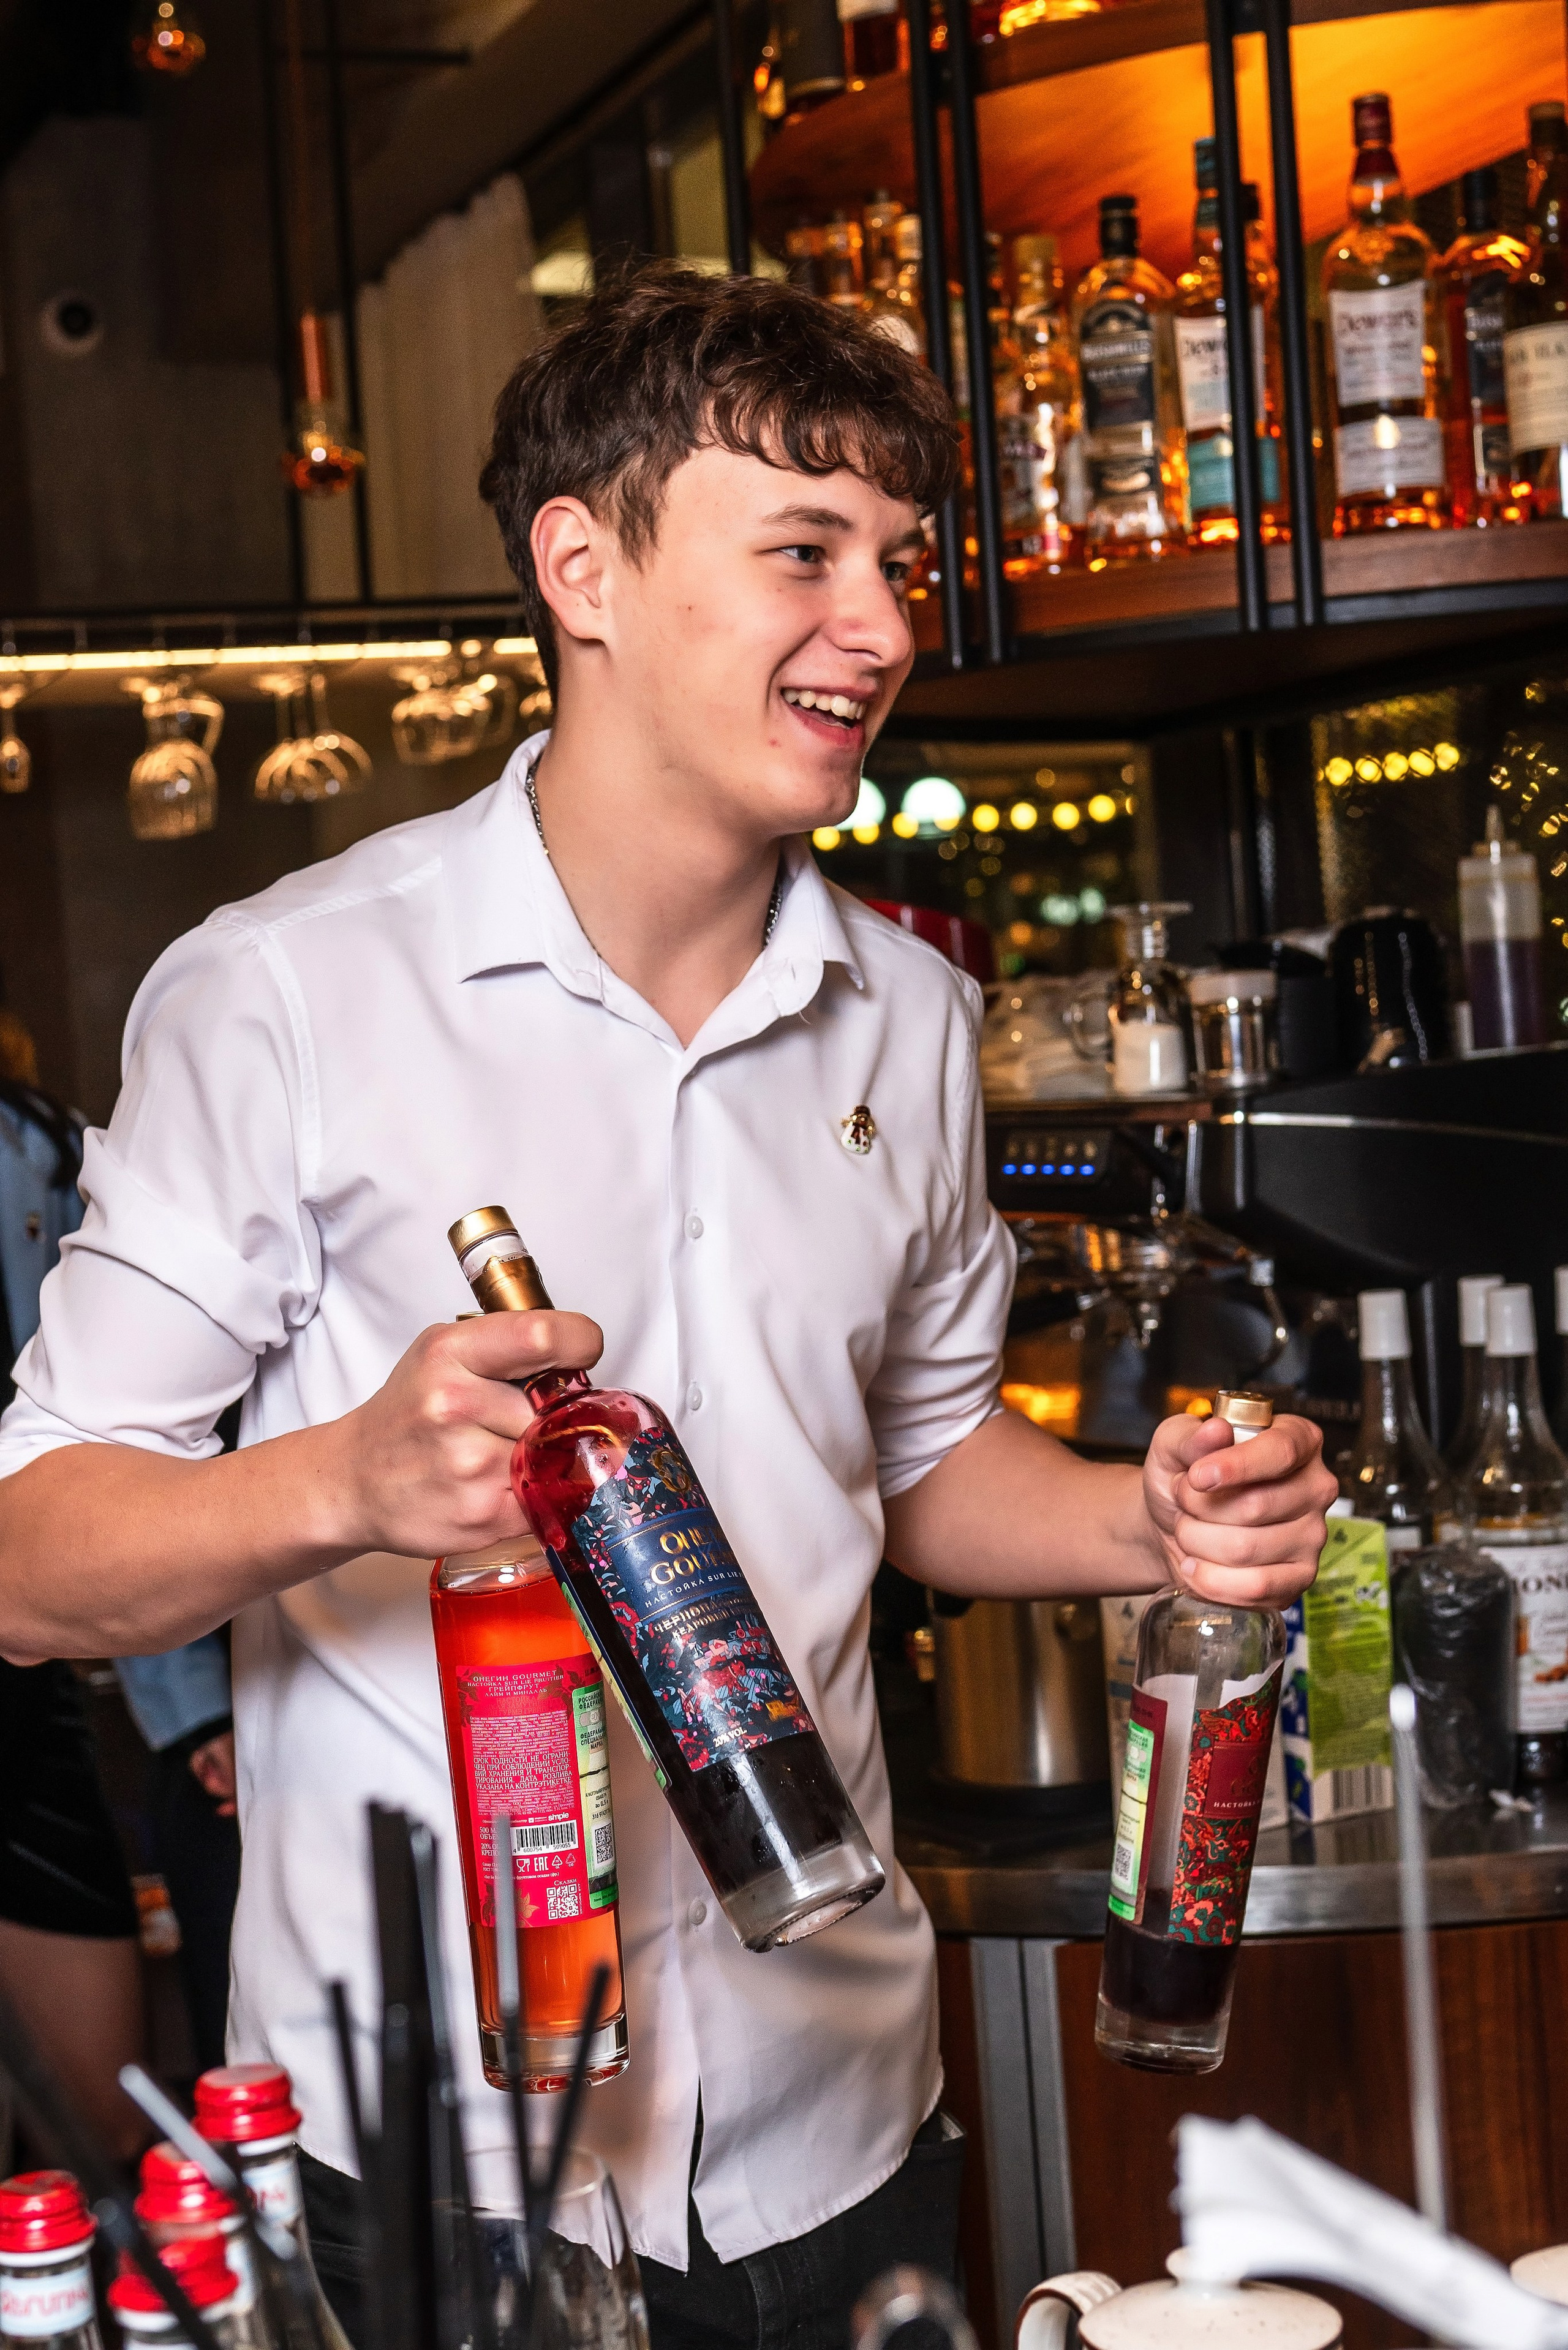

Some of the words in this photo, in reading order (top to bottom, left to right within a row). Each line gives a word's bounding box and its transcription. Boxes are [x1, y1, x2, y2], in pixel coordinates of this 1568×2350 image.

[645, 1578, 705, 1608] НАСТОЙКА
[707, 1572, 725, 1582] SUR
[513, 1670, 557, 1680] GOURMET
[534, 1674, 564, 1683] FRUITIER
[728, 1727, 747, 1739] VOL.
[542, 1752, 571, 1761] ОГРАНИ-
[501, 1761, 550, 1770] СОБЛЮДЕНИИ
[551, 1757, 571, 1766] УСЛО-
[533, 1764, 571, 1774] ТРАНСПОР-
[542, 1771, 573, 1780] РОЗЛИВА
[515, 1777, 573, 1789] КОНТРЭТИКЕТКЕ.
